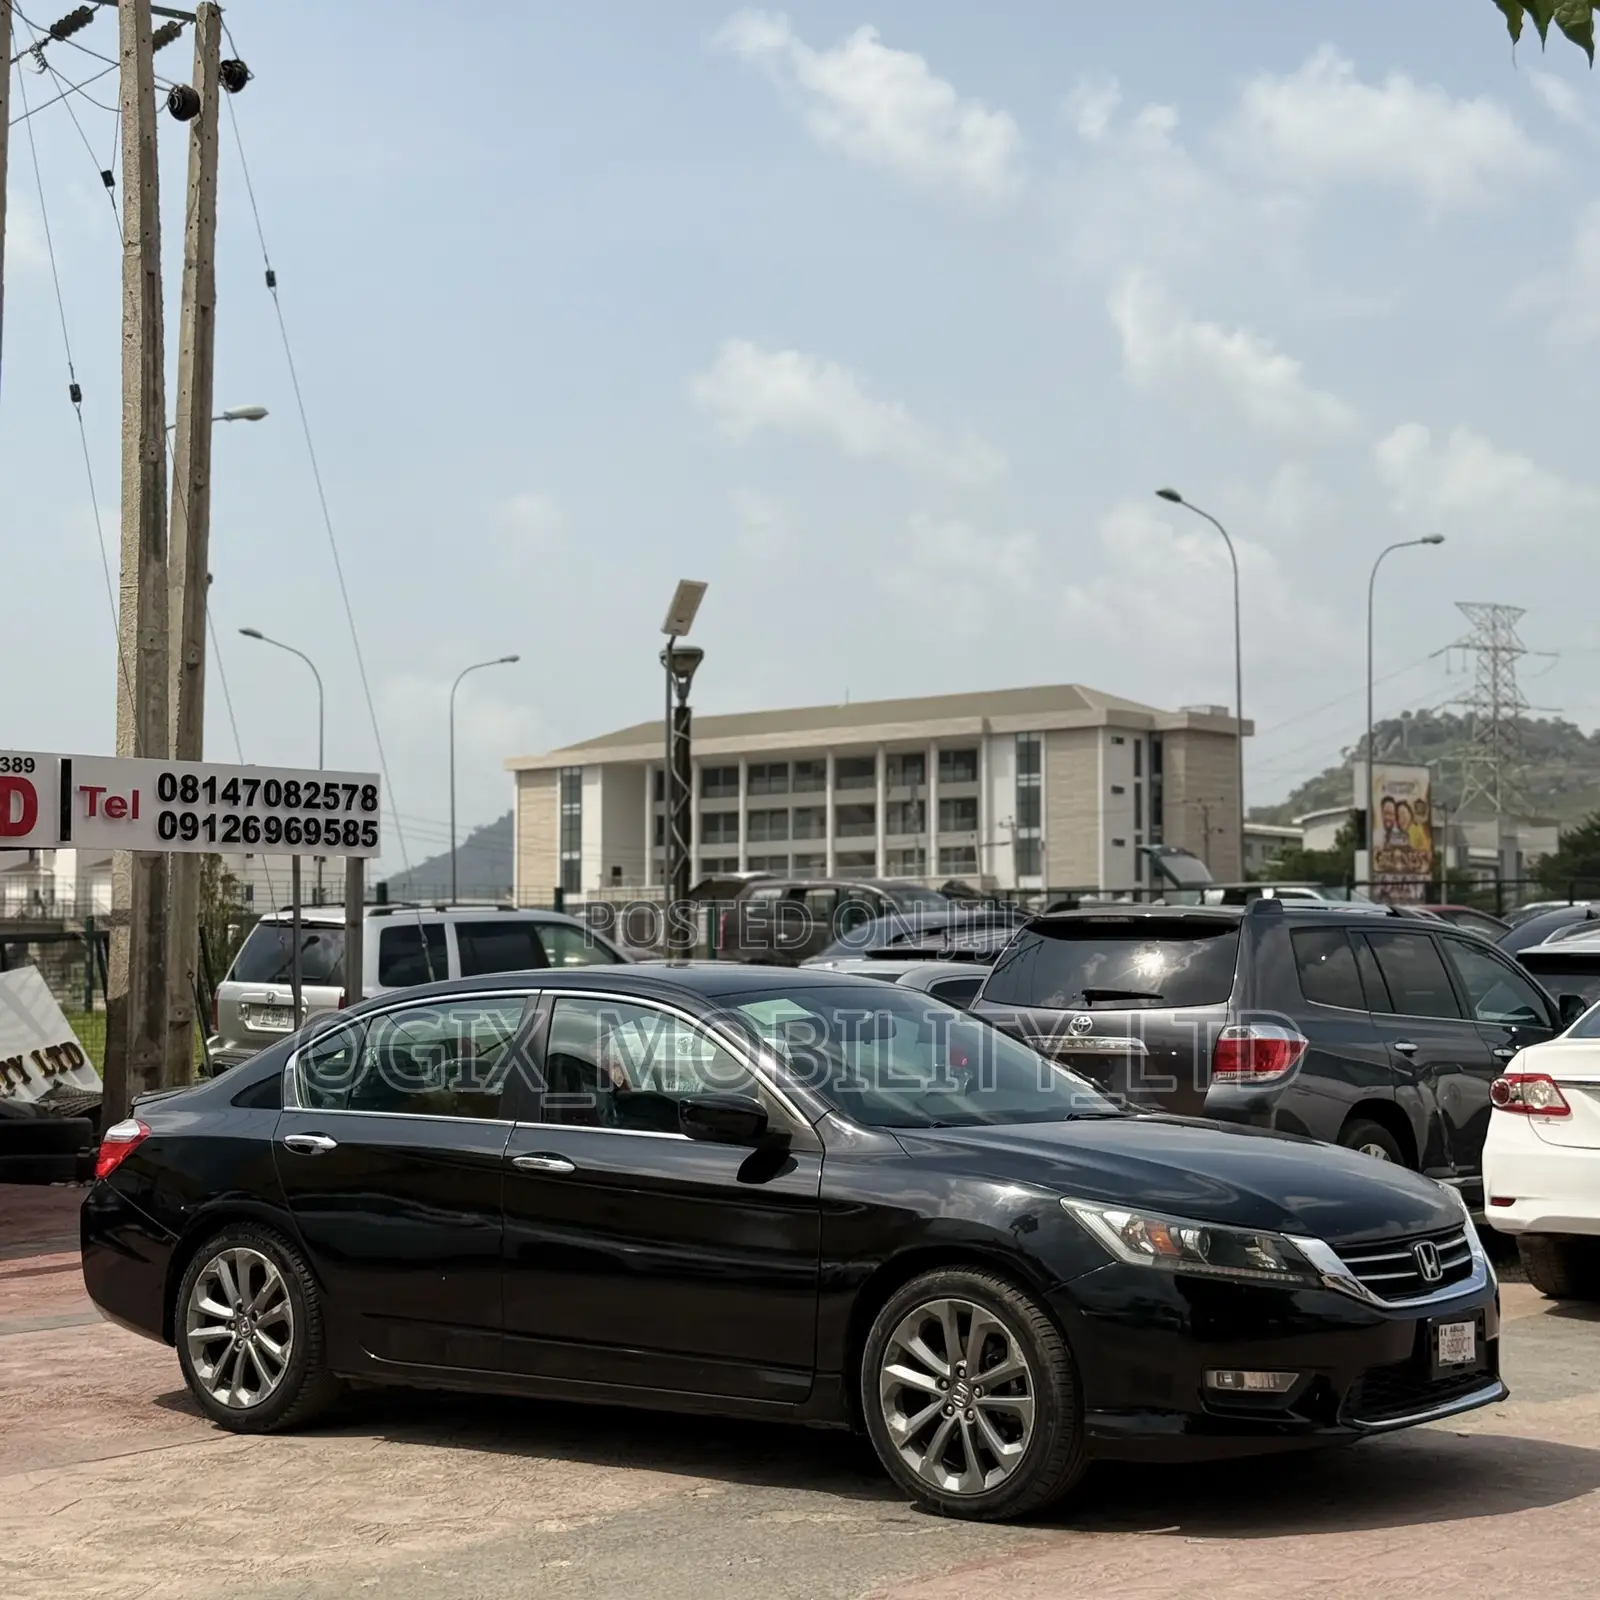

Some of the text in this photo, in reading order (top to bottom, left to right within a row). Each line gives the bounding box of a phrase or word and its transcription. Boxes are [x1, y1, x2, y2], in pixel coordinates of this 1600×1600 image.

[0, 757, 35, 773] 389
[79, 785, 140, 820] Tel
[156, 772, 379, 812] 08147082578
[156, 810, 379, 848] 09126969585
[30, 1041, 85, 1078] LTD
